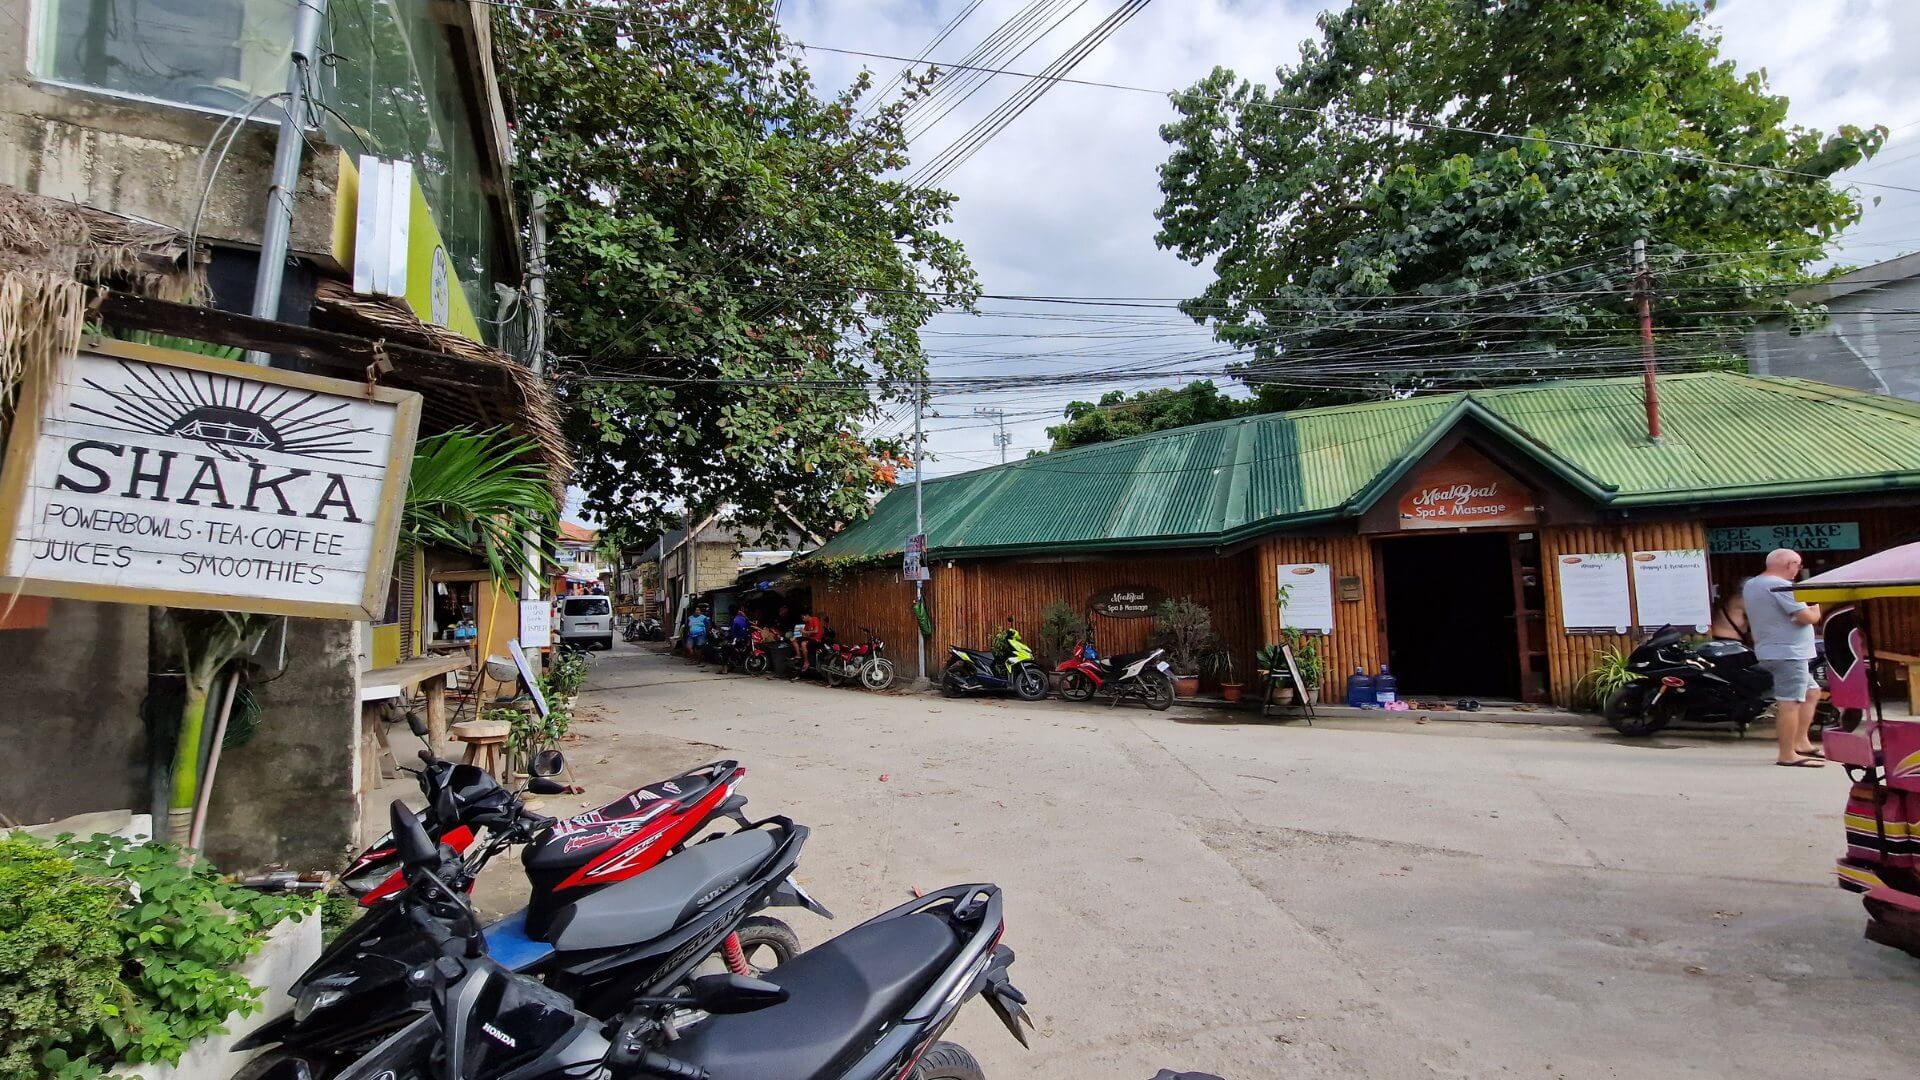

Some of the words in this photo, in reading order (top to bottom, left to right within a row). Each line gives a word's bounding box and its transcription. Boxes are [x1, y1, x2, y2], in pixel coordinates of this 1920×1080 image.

[55, 440, 362, 523] SHAKA
[1416, 506, 1436, 519] Spa
[1438, 505, 1447, 516] &
[1451, 503, 1506, 516] Massage
[44, 503, 192, 541] POWERBOWLS
[205, 521, 243, 546] TEA
[251, 526, 345, 557] COFFEE
[1773, 524, 1842, 539] SHAKE
[1779, 537, 1830, 550] CAKE
[34, 540, 132, 568] JUICES
[179, 552, 325, 586] SMOOTHIES
[1107, 604, 1119, 613] Spa
[1124, 604, 1149, 612] Massage
[482, 1022, 516, 1048] HONDA
